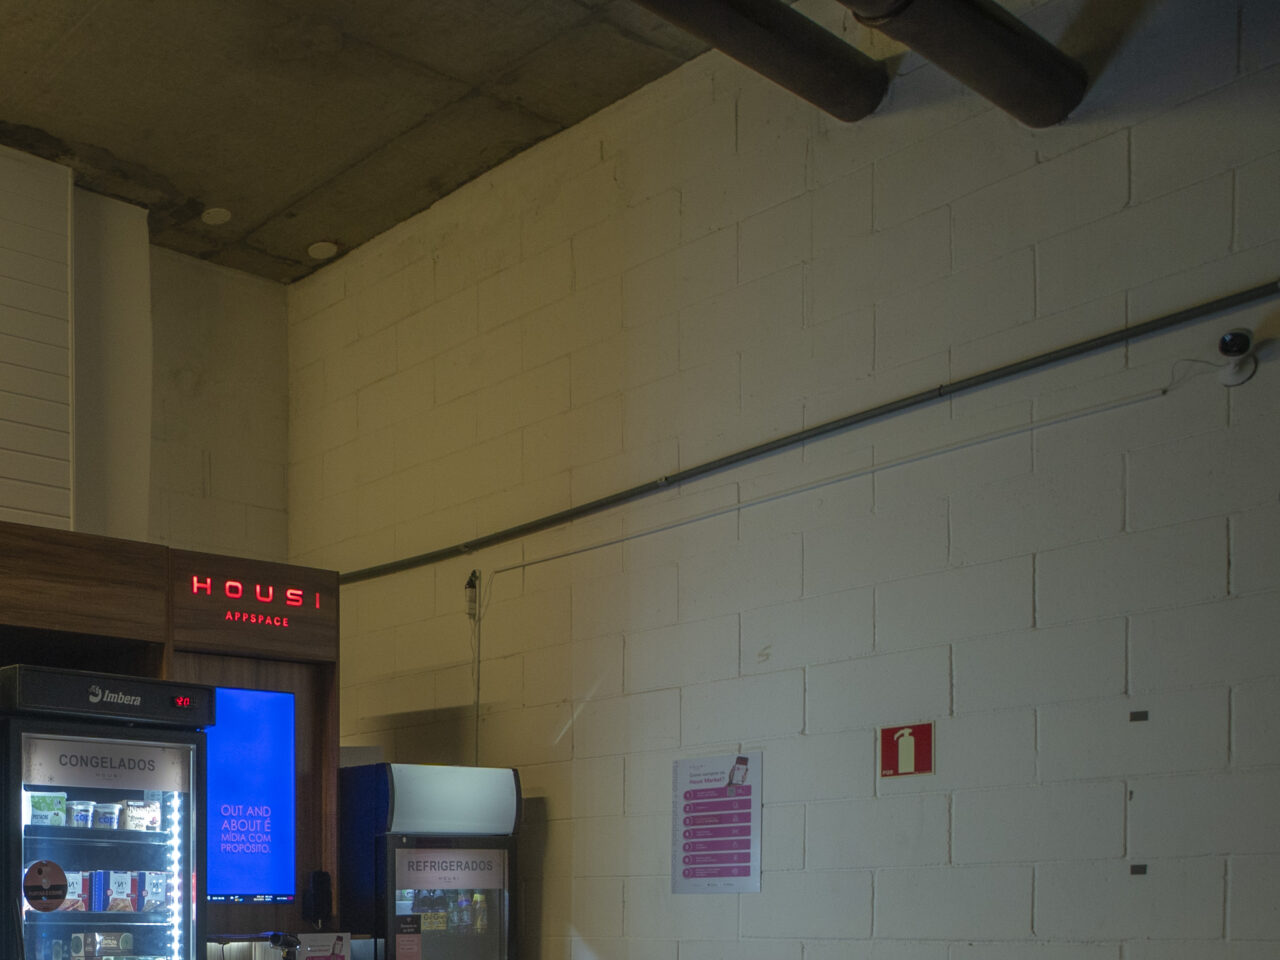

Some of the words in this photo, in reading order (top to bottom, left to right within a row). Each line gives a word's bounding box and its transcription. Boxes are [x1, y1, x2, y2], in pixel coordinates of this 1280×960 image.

[192, 576, 321, 609] HOUSI
[225, 610, 289, 627] APPSPACE
[102, 690, 141, 706] Imbera
[59, 754, 156, 772] CONGELADOS
[220, 804, 243, 817] OUT
[246, 806, 271, 817] AND
[222, 819, 261, 832] ABOUT
[264, 817, 271, 832] É
[221, 831, 246, 842] MÍDIA
[248, 833, 272, 842] COM
[221, 842, 272, 853] PROPÓSITO.
[407, 860, 493, 873] REFRIGERADOS
